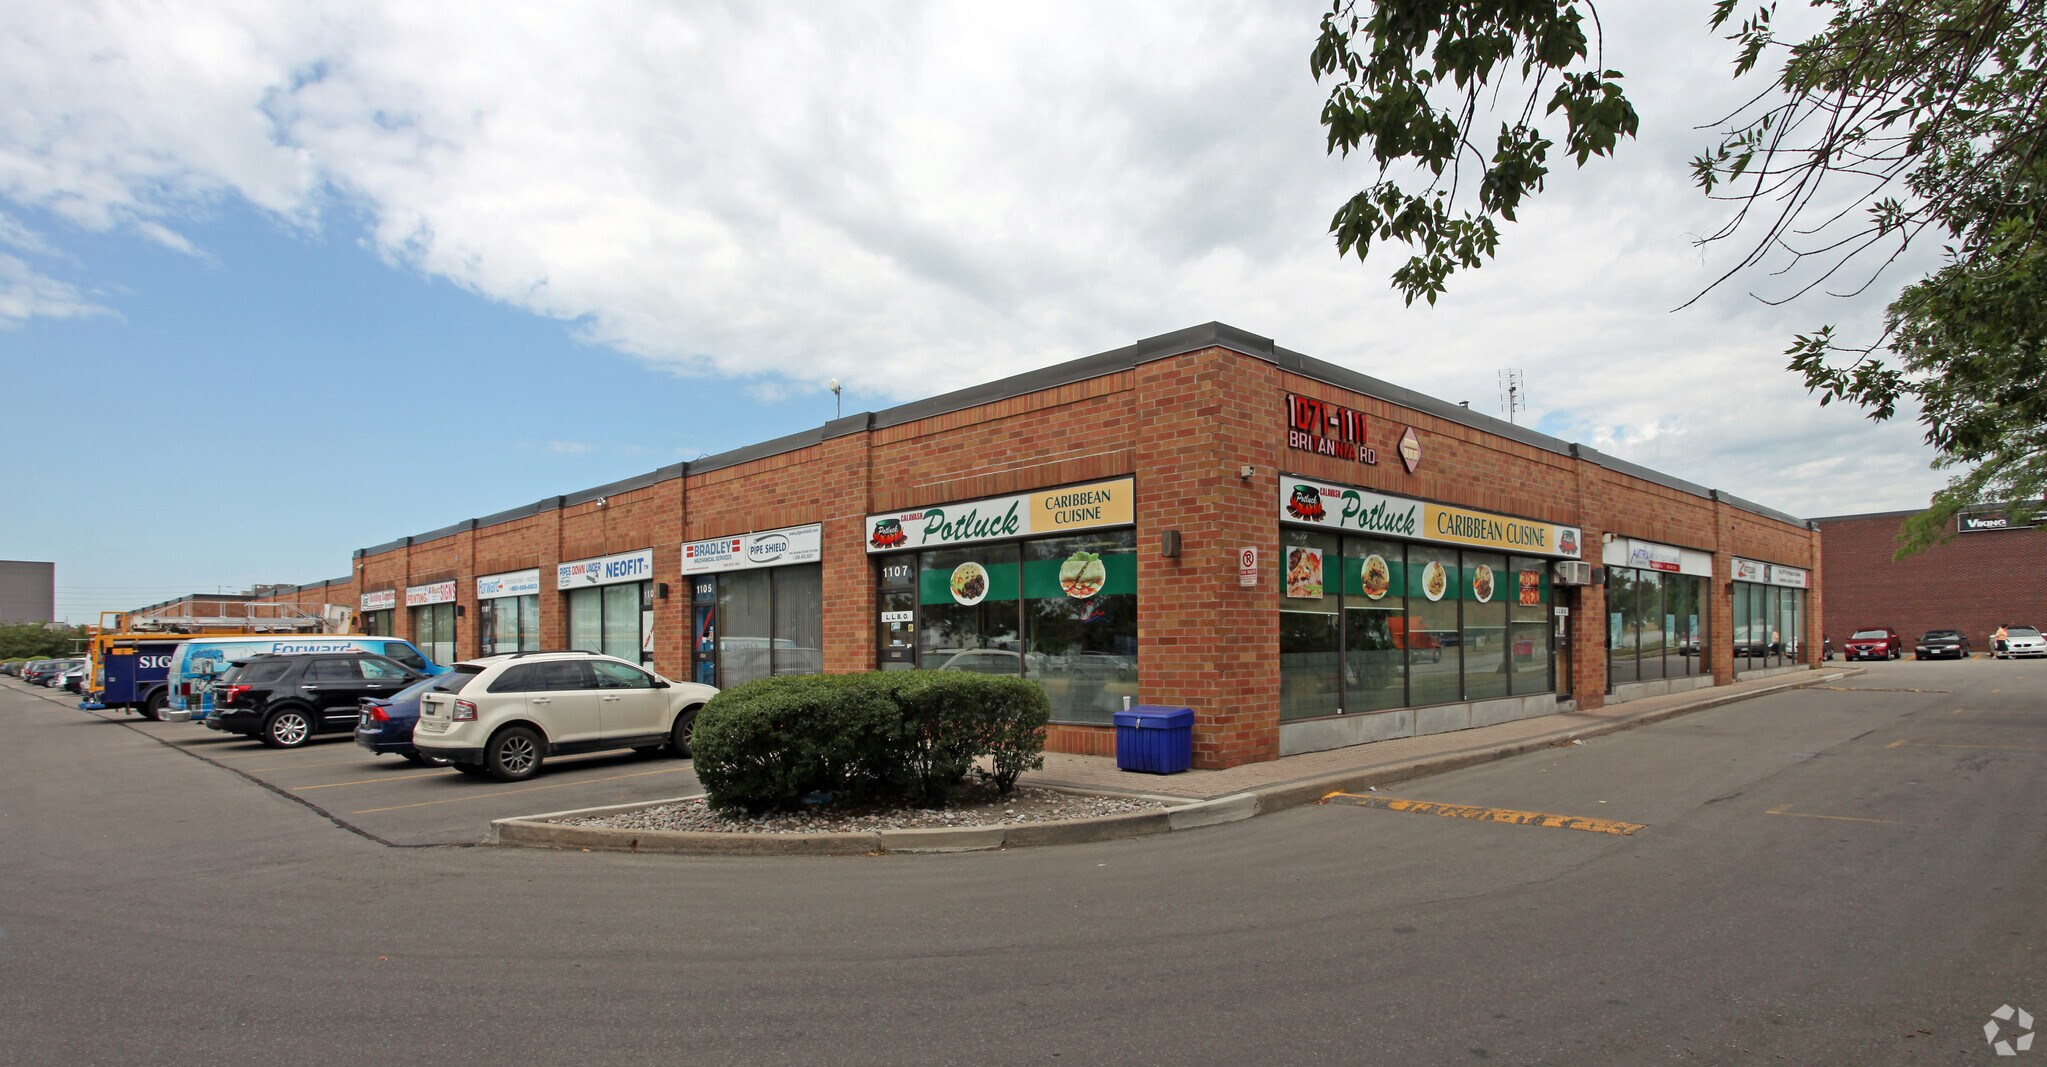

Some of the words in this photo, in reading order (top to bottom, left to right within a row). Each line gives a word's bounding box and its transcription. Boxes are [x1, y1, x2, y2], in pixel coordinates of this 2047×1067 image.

[1287, 394, 1367, 445] 1071-1111
[1288, 430, 1356, 461] BRITANNIA
[1045, 489, 1111, 510] CARIBBEAN
[1296, 492, 1317, 504] Potluck
[1055, 506, 1101, 524] CUISINE
[1341, 490, 1416, 535] Potluck
[878, 525, 899, 535] Potluck
[922, 500, 1019, 544] Potluck
[1437, 512, 1503, 541] CARIBBEAN
[1506, 523, 1545, 547] CUISINE
[694, 540, 731, 557] BRADLEY
[750, 545, 763, 555] PIPE
[765, 542, 787, 553] SHIELD
[572, 564, 585, 575] DOWN
[586, 562, 601, 573] UNDER
[606, 558, 644, 578] NEOFIT
[883, 565, 908, 578] 1107
[479, 578, 500, 594] Forward
[697, 583, 712, 594] 1105
